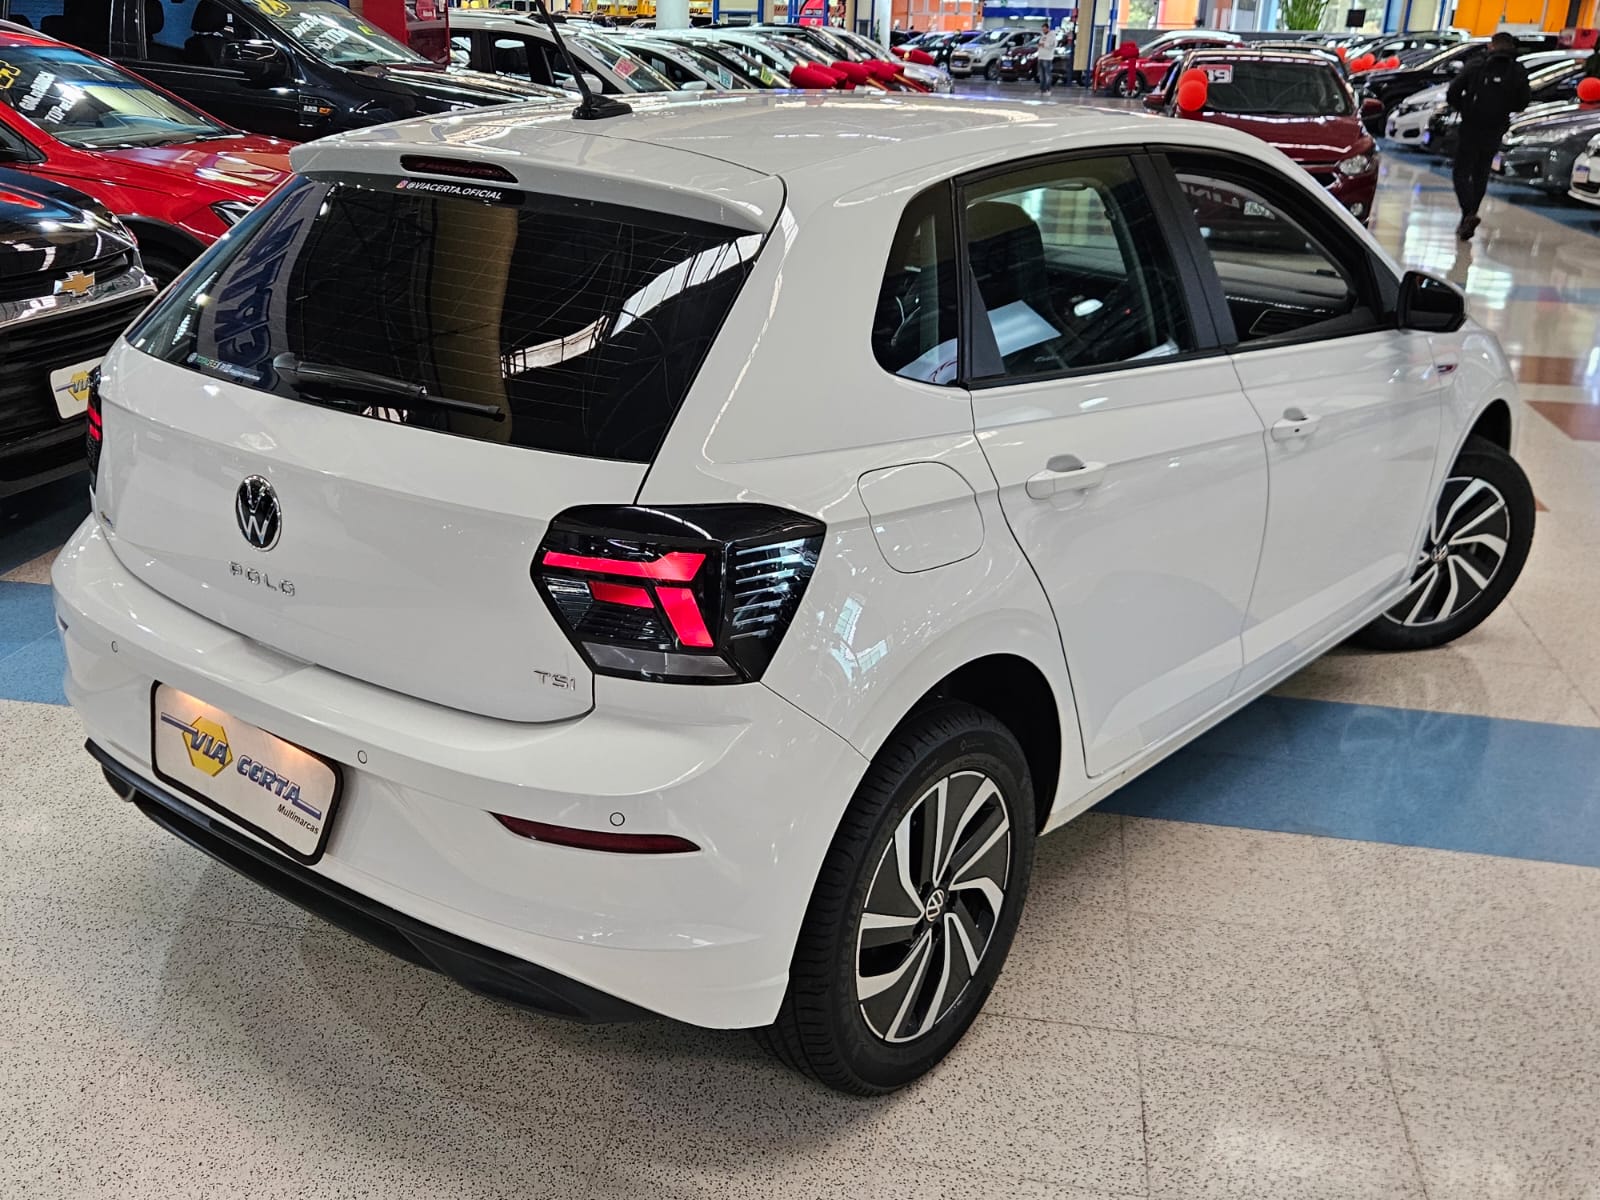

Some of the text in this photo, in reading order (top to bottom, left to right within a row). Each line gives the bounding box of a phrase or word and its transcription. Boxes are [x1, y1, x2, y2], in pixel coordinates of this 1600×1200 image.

[406, 181, 502, 200] @VIACERTA.OFICIAL
[229, 560, 296, 597] POLO
[189, 731, 303, 804] VIA CERTA
[276, 803, 320, 835] Multimarcas
